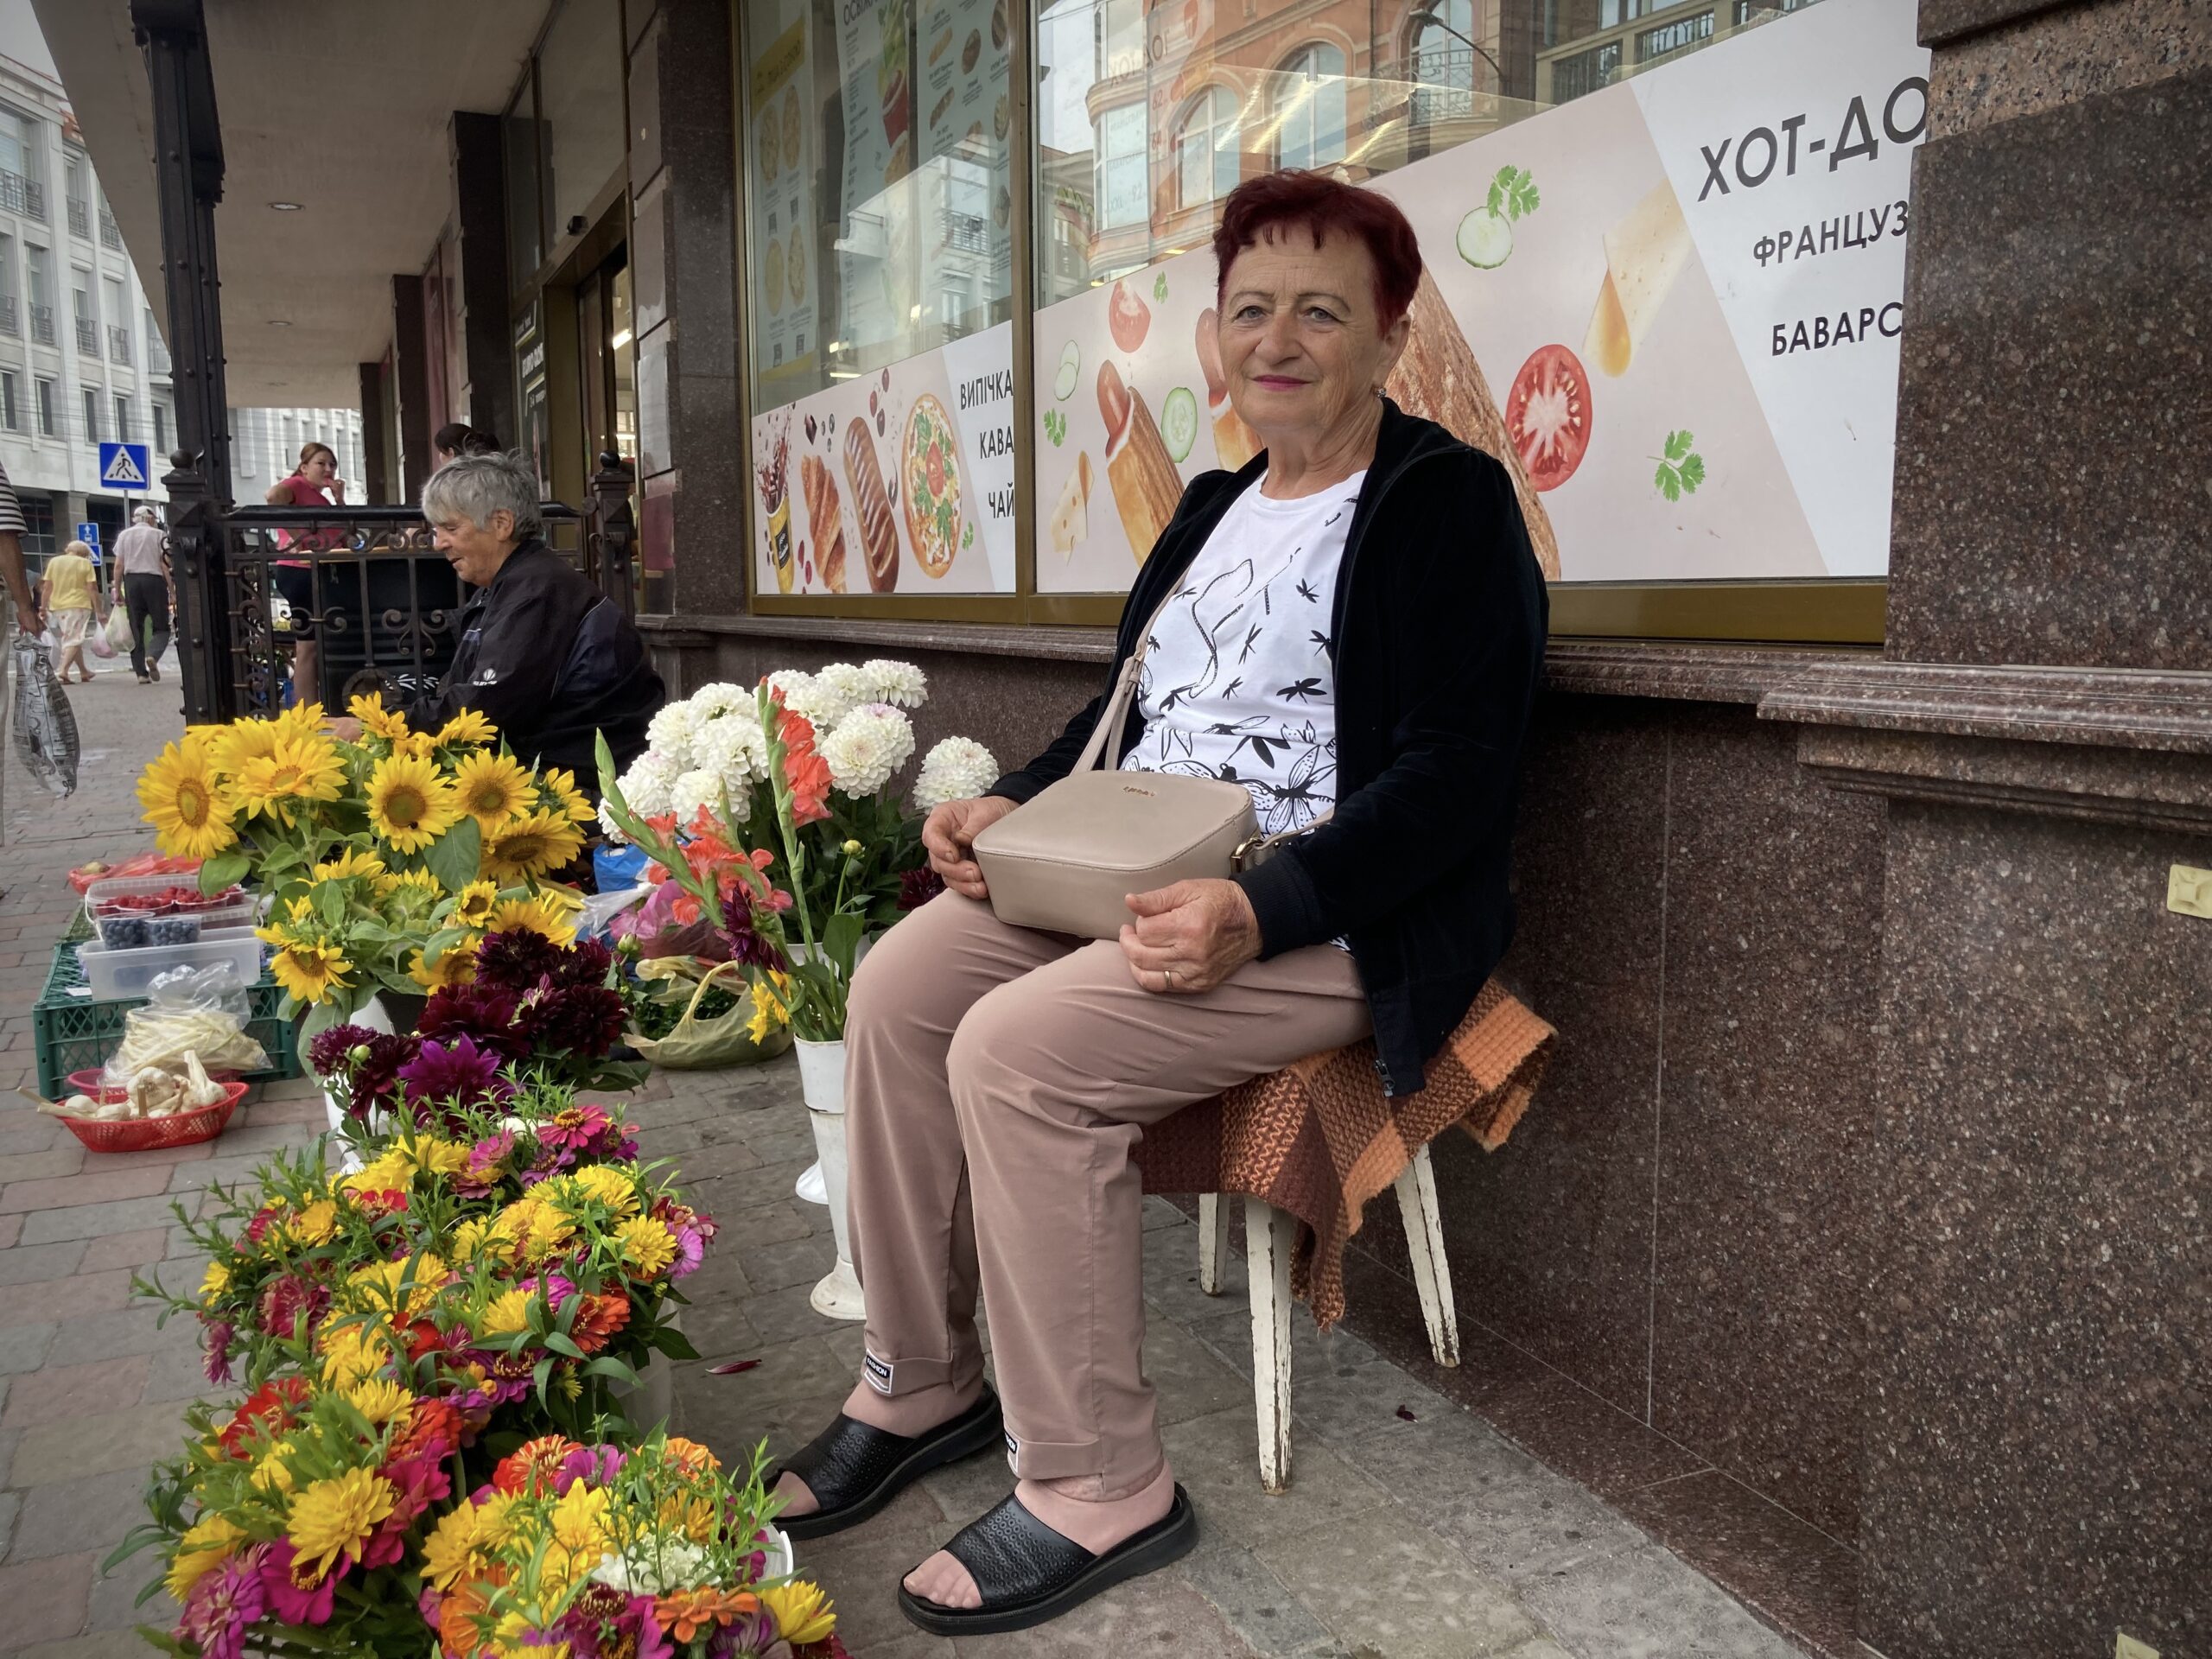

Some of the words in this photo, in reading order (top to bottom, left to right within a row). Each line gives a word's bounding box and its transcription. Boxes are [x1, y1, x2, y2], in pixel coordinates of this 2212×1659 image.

[1698, 77, 1928, 201] ХОТ-ДО
[1753, 200, 1908, 267] ФРАНЦУЗ
[1772, 302, 1903, 356] БАВАРС
[960, 369, 1013, 410] ВИПІЧКА
[979, 426, 1014, 459] КАВА
[988, 481, 1014, 518] ЧАЙ
